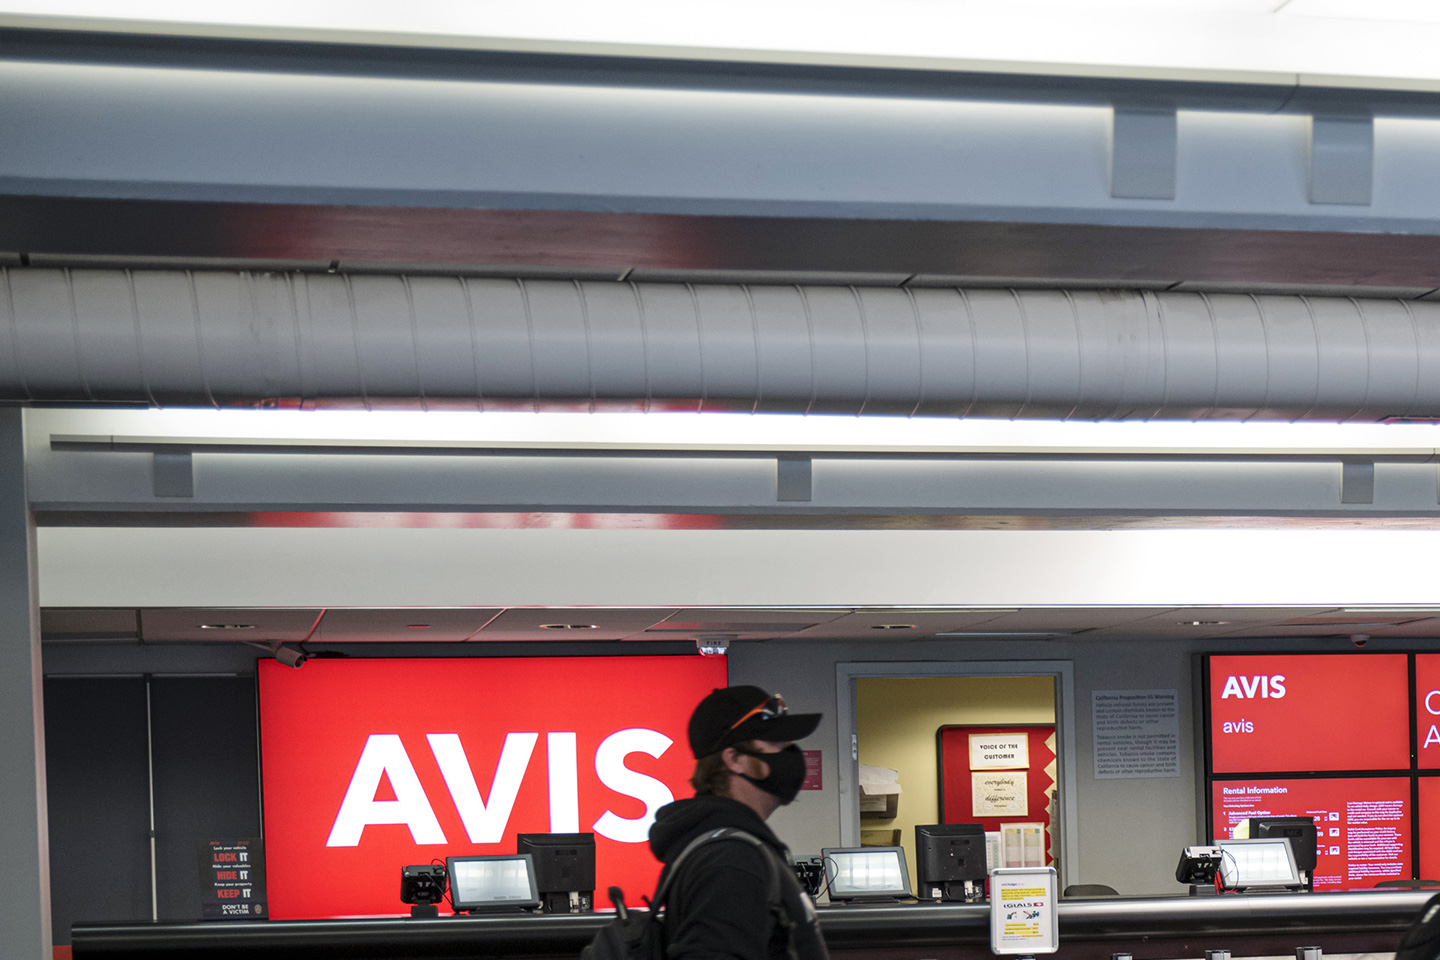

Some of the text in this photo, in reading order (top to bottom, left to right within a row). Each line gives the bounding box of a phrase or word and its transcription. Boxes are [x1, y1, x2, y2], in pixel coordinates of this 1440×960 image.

[1221, 675, 1286, 699] AVIS
[1223, 719, 1254, 733] avis
[985, 778, 1014, 786] everybody
[326, 727, 674, 848] AVIS
[1223, 786, 1288, 795] Rental Information
[985, 794, 1015, 803] difference
[214, 852, 248, 862] LOCK IT
[217, 871, 248, 880] HIDE IT
[217, 889, 251, 898] KEEP IT
